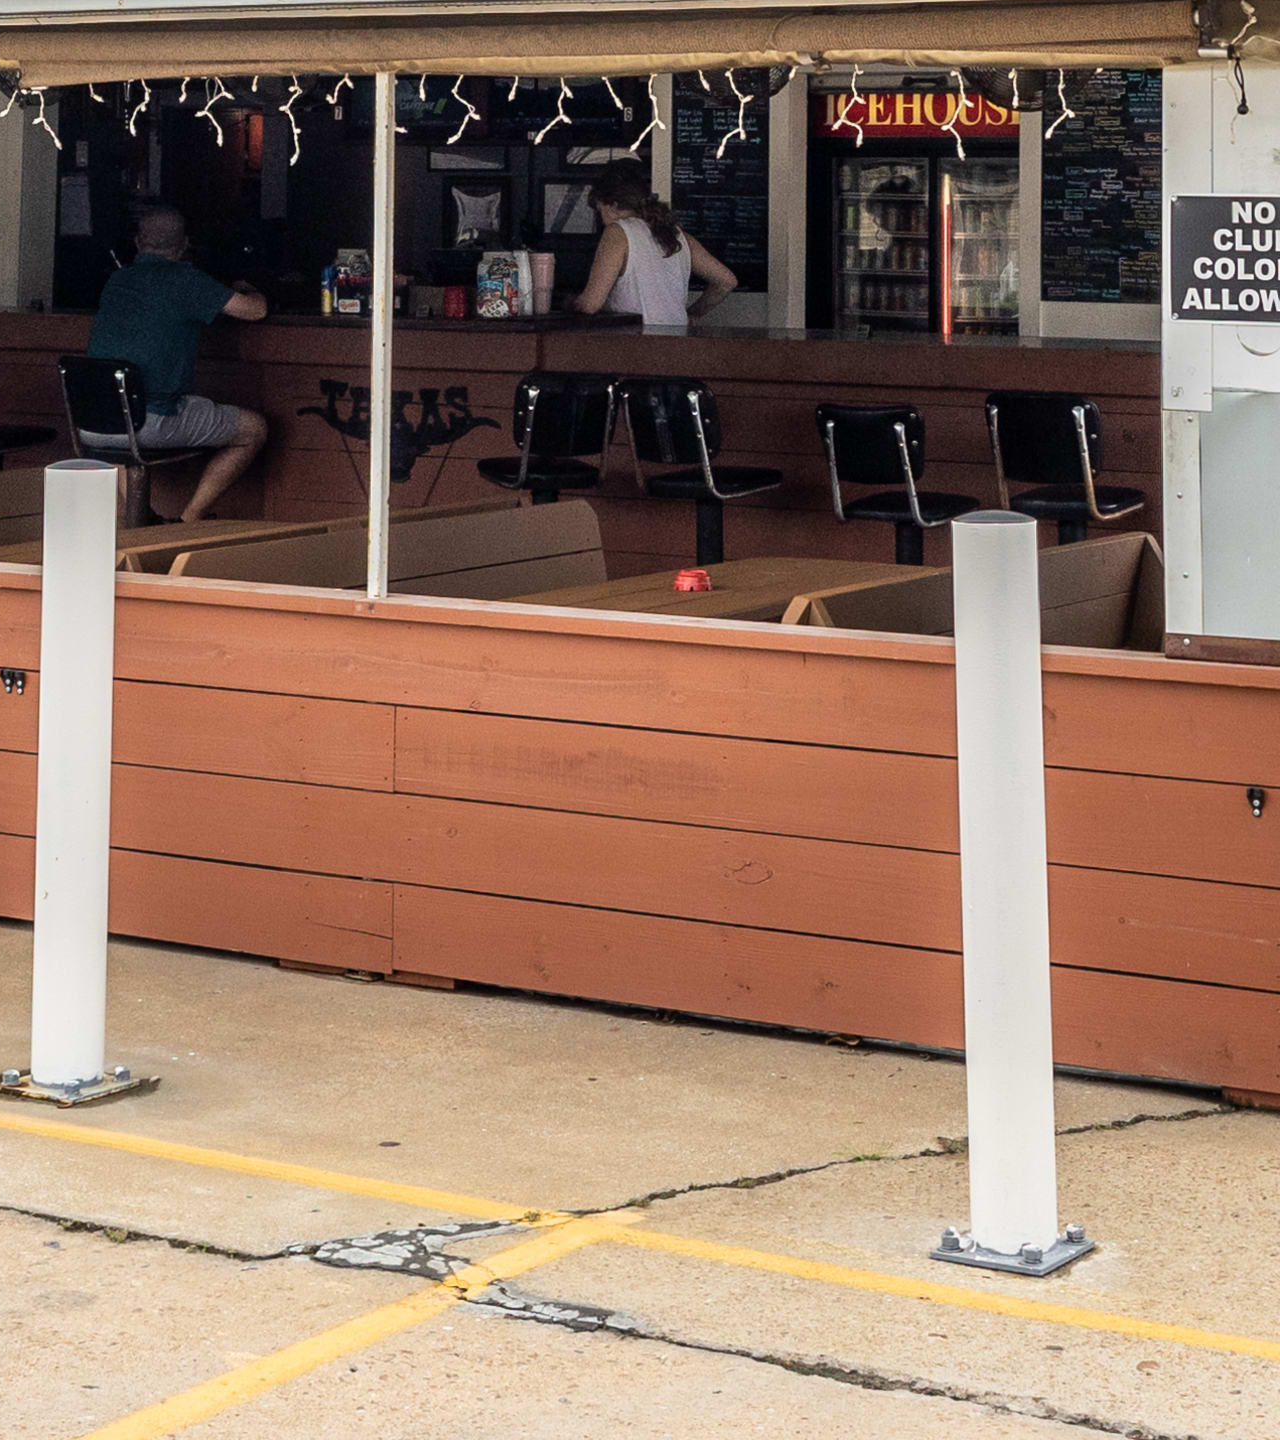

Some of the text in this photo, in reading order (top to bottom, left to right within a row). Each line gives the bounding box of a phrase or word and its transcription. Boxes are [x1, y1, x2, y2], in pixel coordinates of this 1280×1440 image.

[824, 93, 1020, 126] ICEHOUS
[1232, 201, 1276, 224] NO
[320, 379, 472, 431] TEXAS
